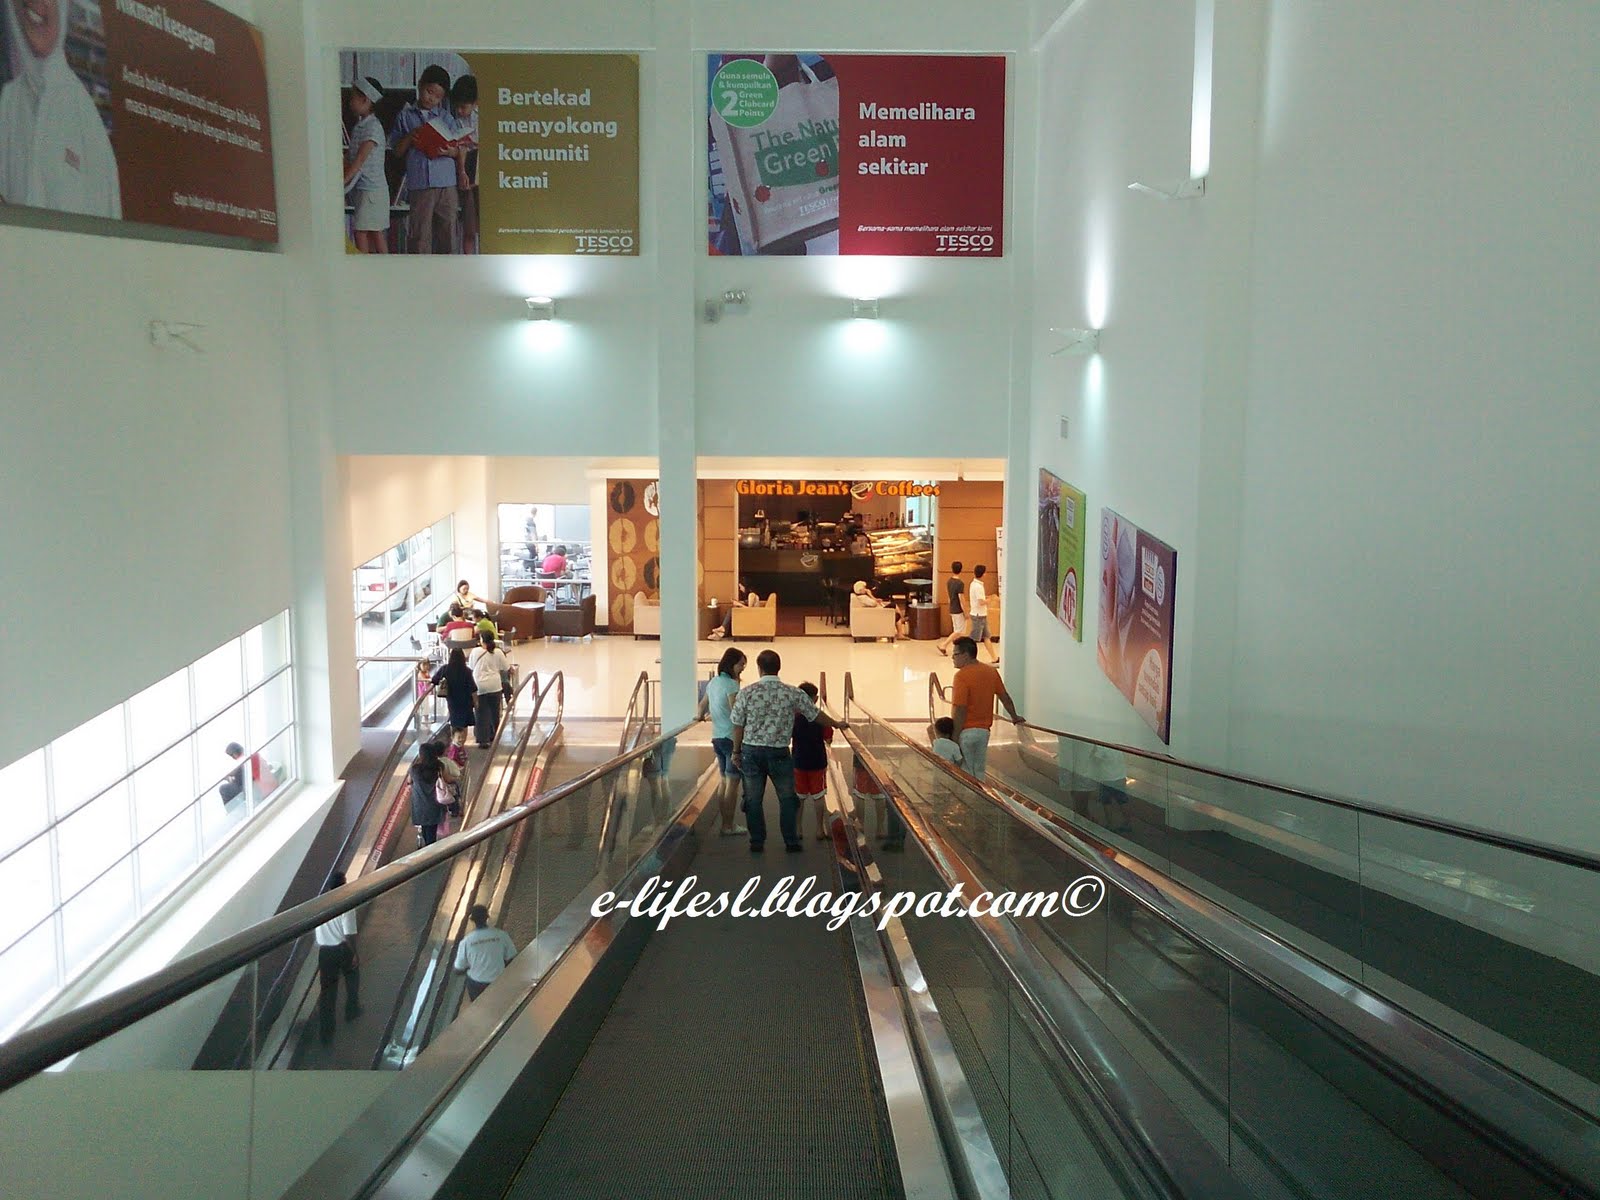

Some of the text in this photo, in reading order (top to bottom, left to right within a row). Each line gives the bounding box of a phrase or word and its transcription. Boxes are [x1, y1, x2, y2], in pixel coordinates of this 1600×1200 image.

[720, 72, 771, 80] Guna semula
[726, 80, 771, 90] kumpulkan
[498, 88, 591, 106] Bertekad
[721, 90, 738, 116] 2
[739, 91, 763, 99] Green
[739, 100, 775, 108] Clubcard
[859, 102, 975, 120] Memelihara
[739, 109, 765, 117] Points
[498, 116, 617, 139] menyokong
[750, 129, 794, 151] The
[858, 130, 906, 147] alam
[498, 143, 589, 161] komuniti
[764, 143, 831, 174] Green
[858, 157, 928, 175] sekitar
[498, 171, 548, 189] kami
[575, 236, 633, 248] TESCO
[936, 235, 994, 247] TESCO
[737, 480, 941, 497] Gloria Jean's Coffees
